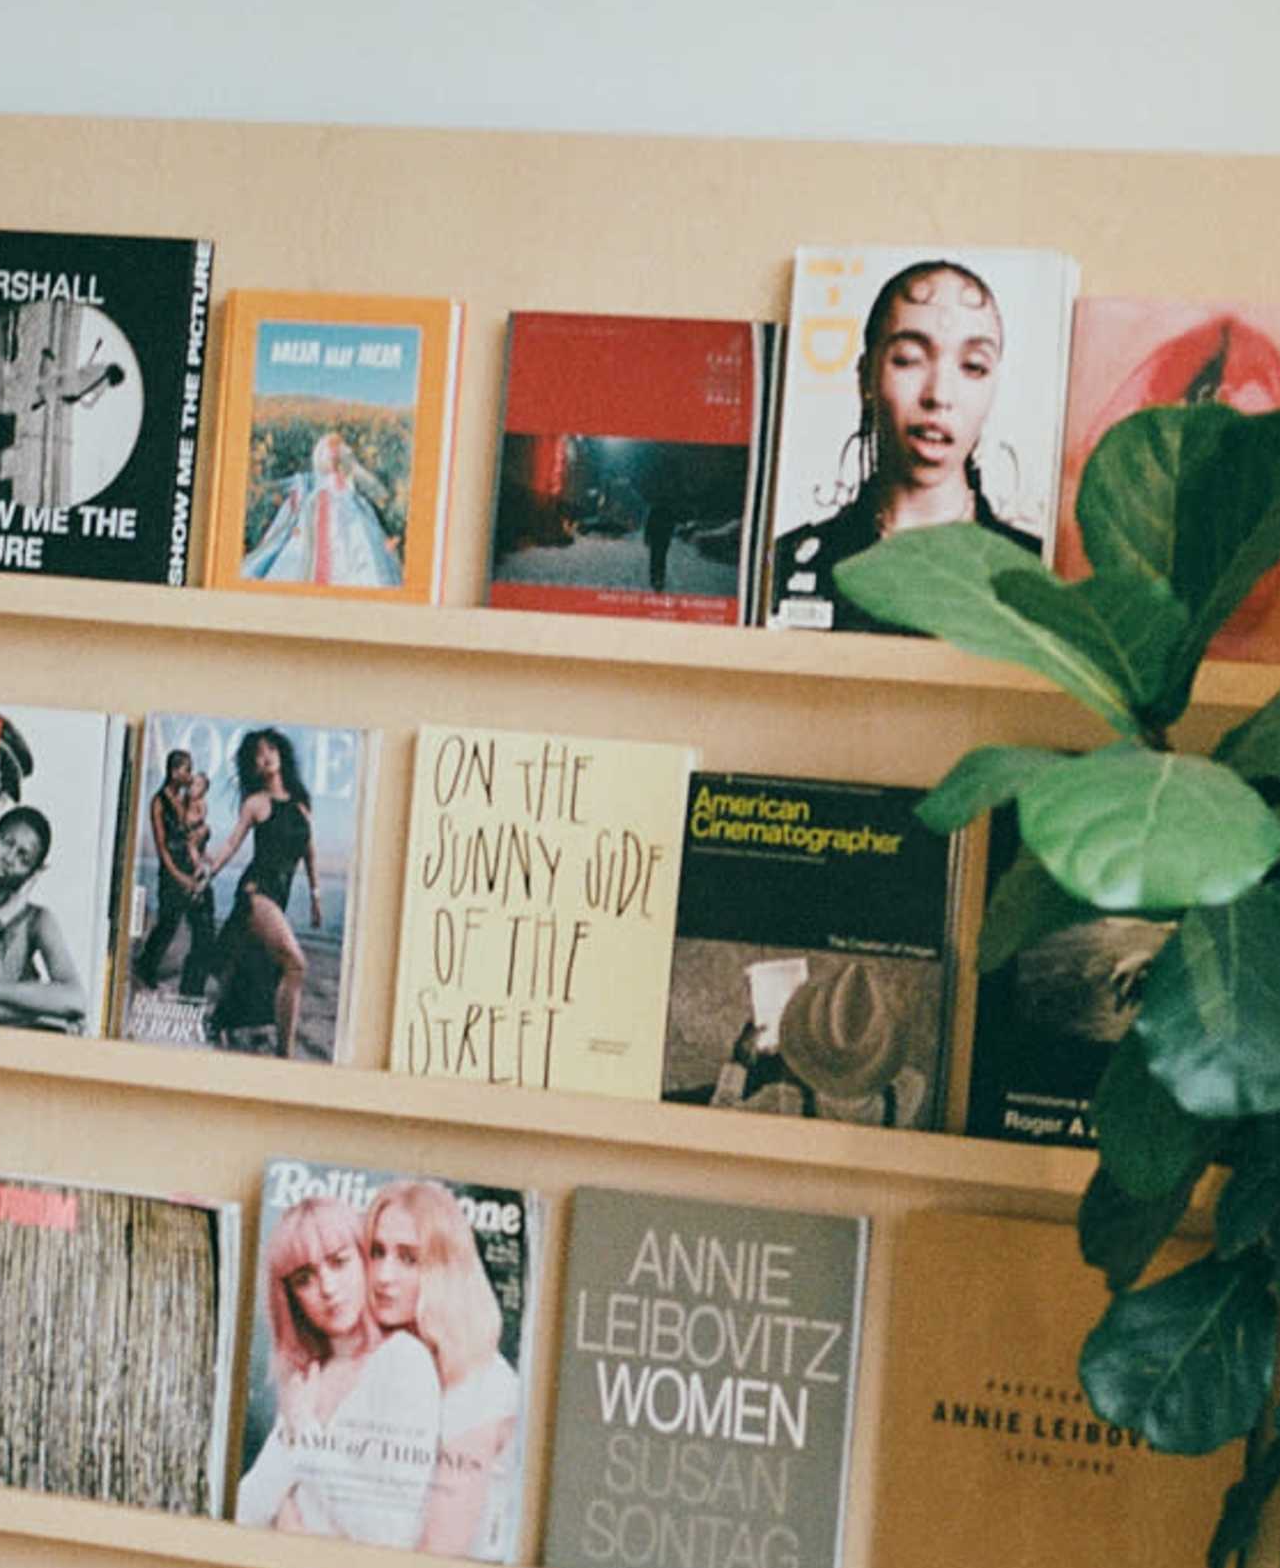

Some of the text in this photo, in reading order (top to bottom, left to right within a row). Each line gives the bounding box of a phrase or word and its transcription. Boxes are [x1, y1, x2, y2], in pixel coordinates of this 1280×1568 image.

[168, 238, 213, 586] SHOW ME THE PICTURE
[22, 503, 69, 534] ME
[78, 506, 137, 540] THE
[144, 710, 356, 800] VOE
[434, 735, 595, 824] ON THE
[690, 811, 903, 856] Cinematographer
[693, 784, 811, 821] American
[423, 813, 665, 919] SUNNY SIDE
[434, 908, 592, 1004] OF THE
[407, 989, 563, 1091] STREET
[1005, 1110, 1063, 1135] Roger
[271, 1161, 376, 1208] Rolli
[457, 1195, 522, 1234] one
[626, 1229, 796, 1308] ANNIE
[575, 1291, 842, 1384] LEIBOVITZ
[596, 1359, 808, 1449] WOMEN
[932, 1400, 1154, 1452] ANNIE LEIBOV
[603, 1433, 790, 1516] SUSAN
